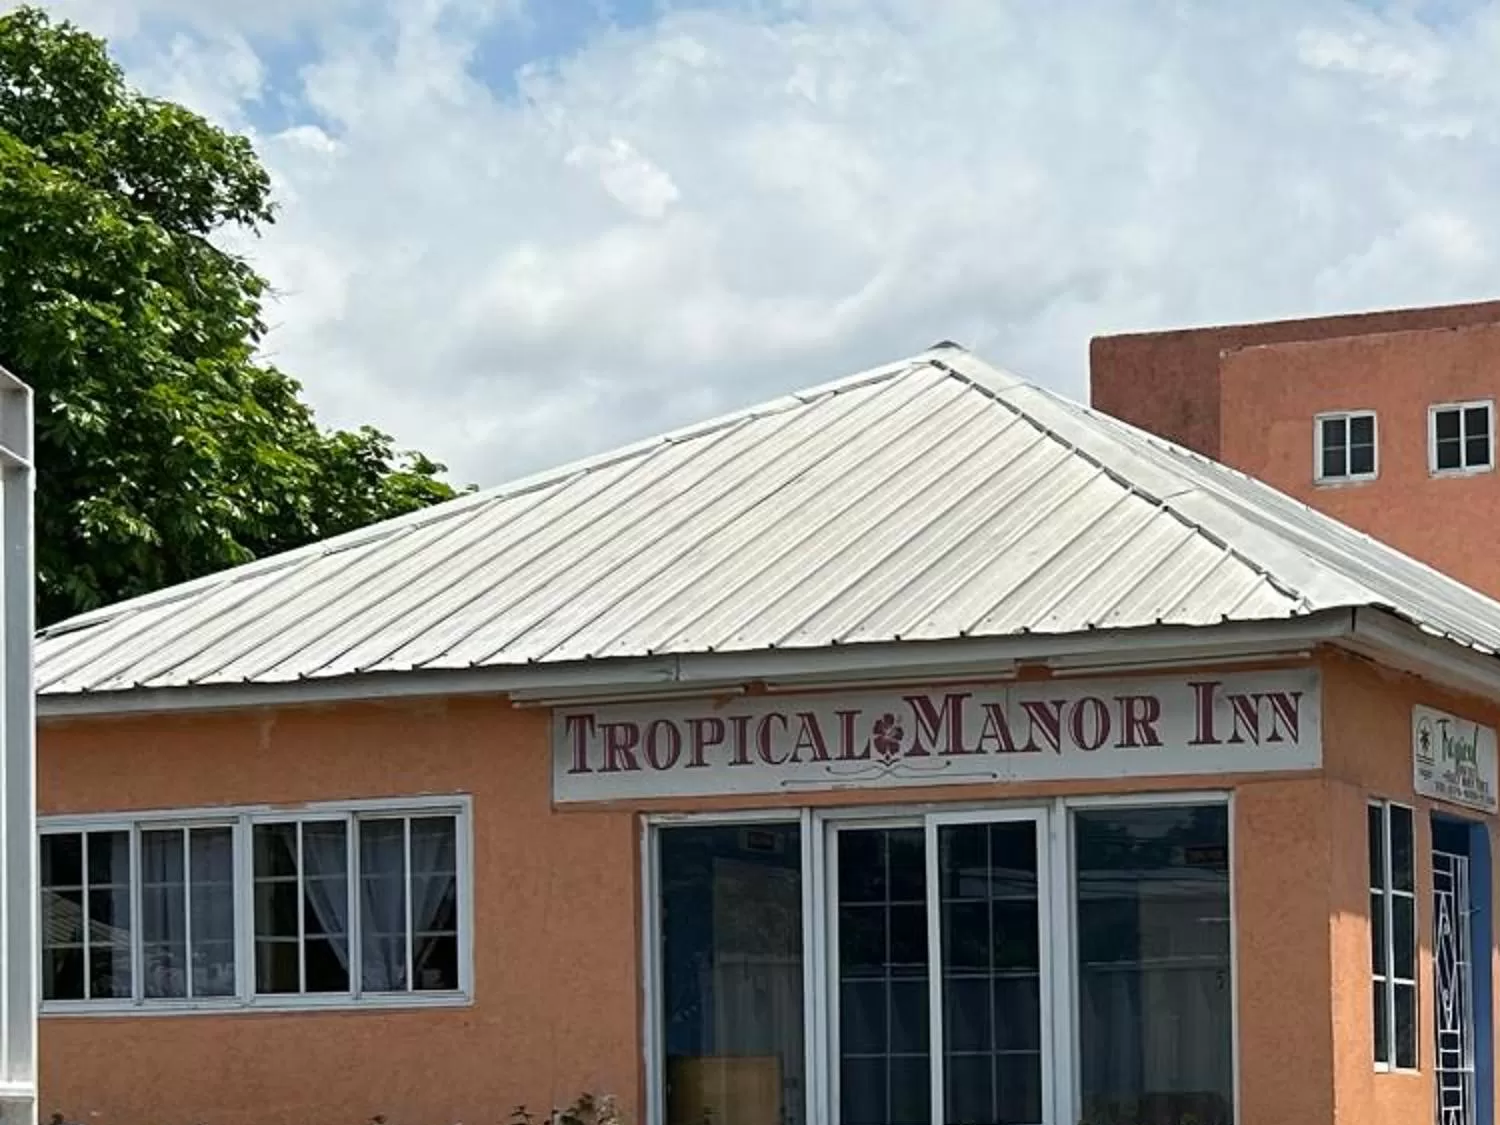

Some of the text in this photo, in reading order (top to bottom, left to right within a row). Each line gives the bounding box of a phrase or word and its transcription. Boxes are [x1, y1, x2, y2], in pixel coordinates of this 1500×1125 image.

[565, 681, 1303, 774] TROPICAL MANOR INN
